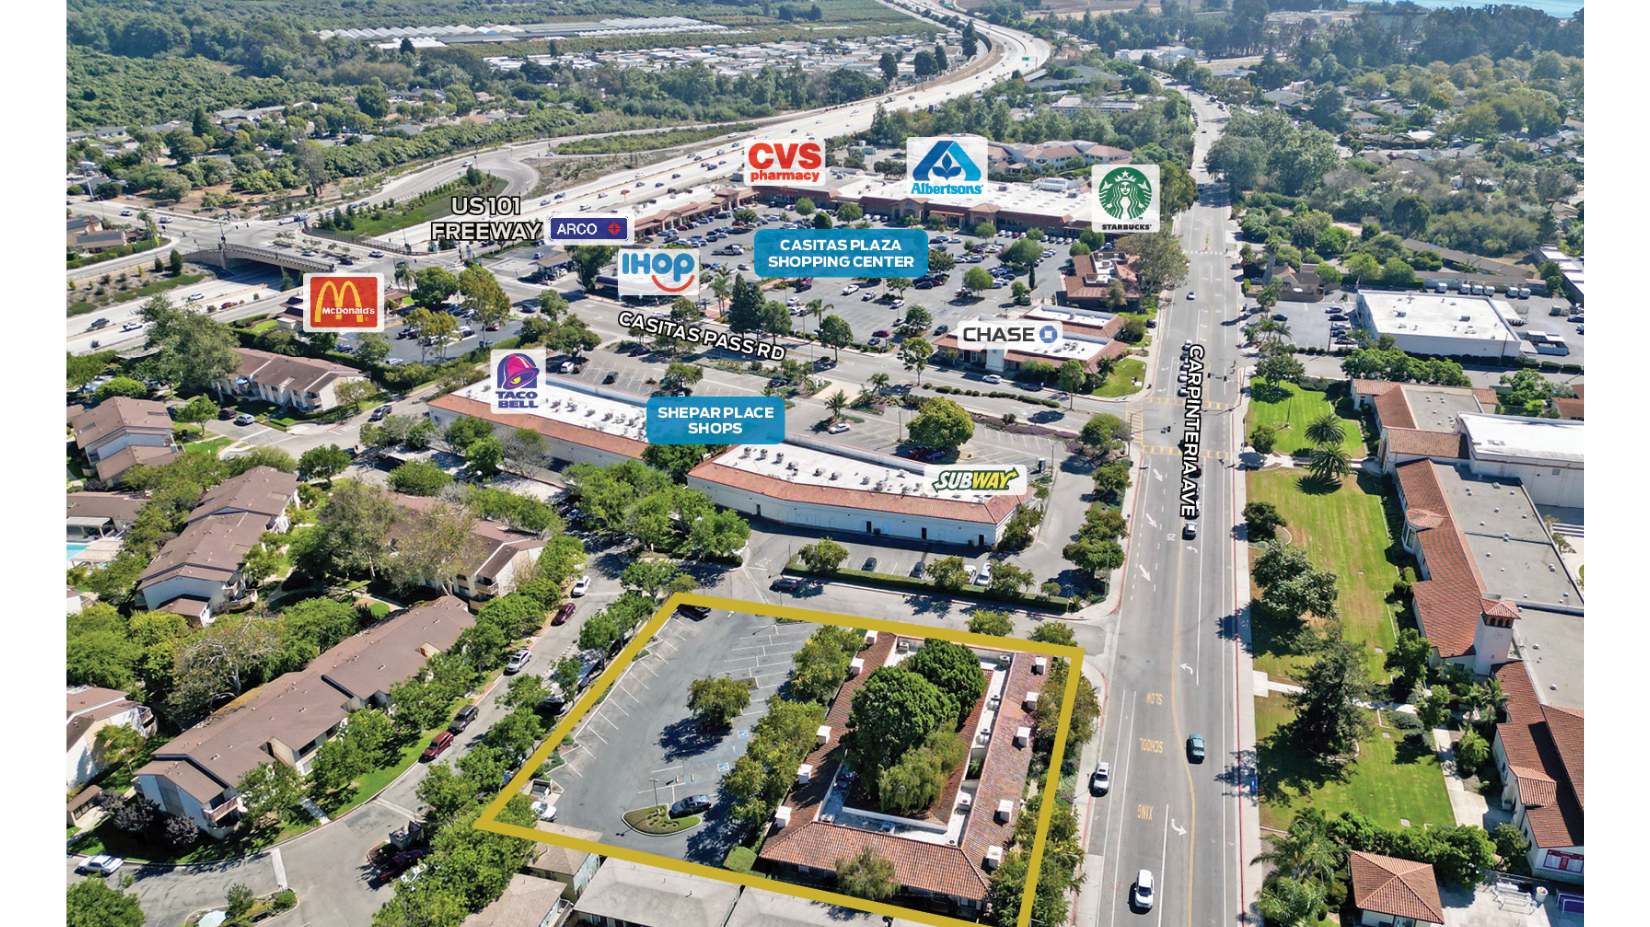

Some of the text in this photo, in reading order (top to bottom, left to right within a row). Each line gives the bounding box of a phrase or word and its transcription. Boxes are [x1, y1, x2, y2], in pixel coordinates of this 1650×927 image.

[1147, 692, 1163, 705] SLOW
[1139, 737, 1163, 754] SCHOOL
[1137, 804, 1153, 820] XING
